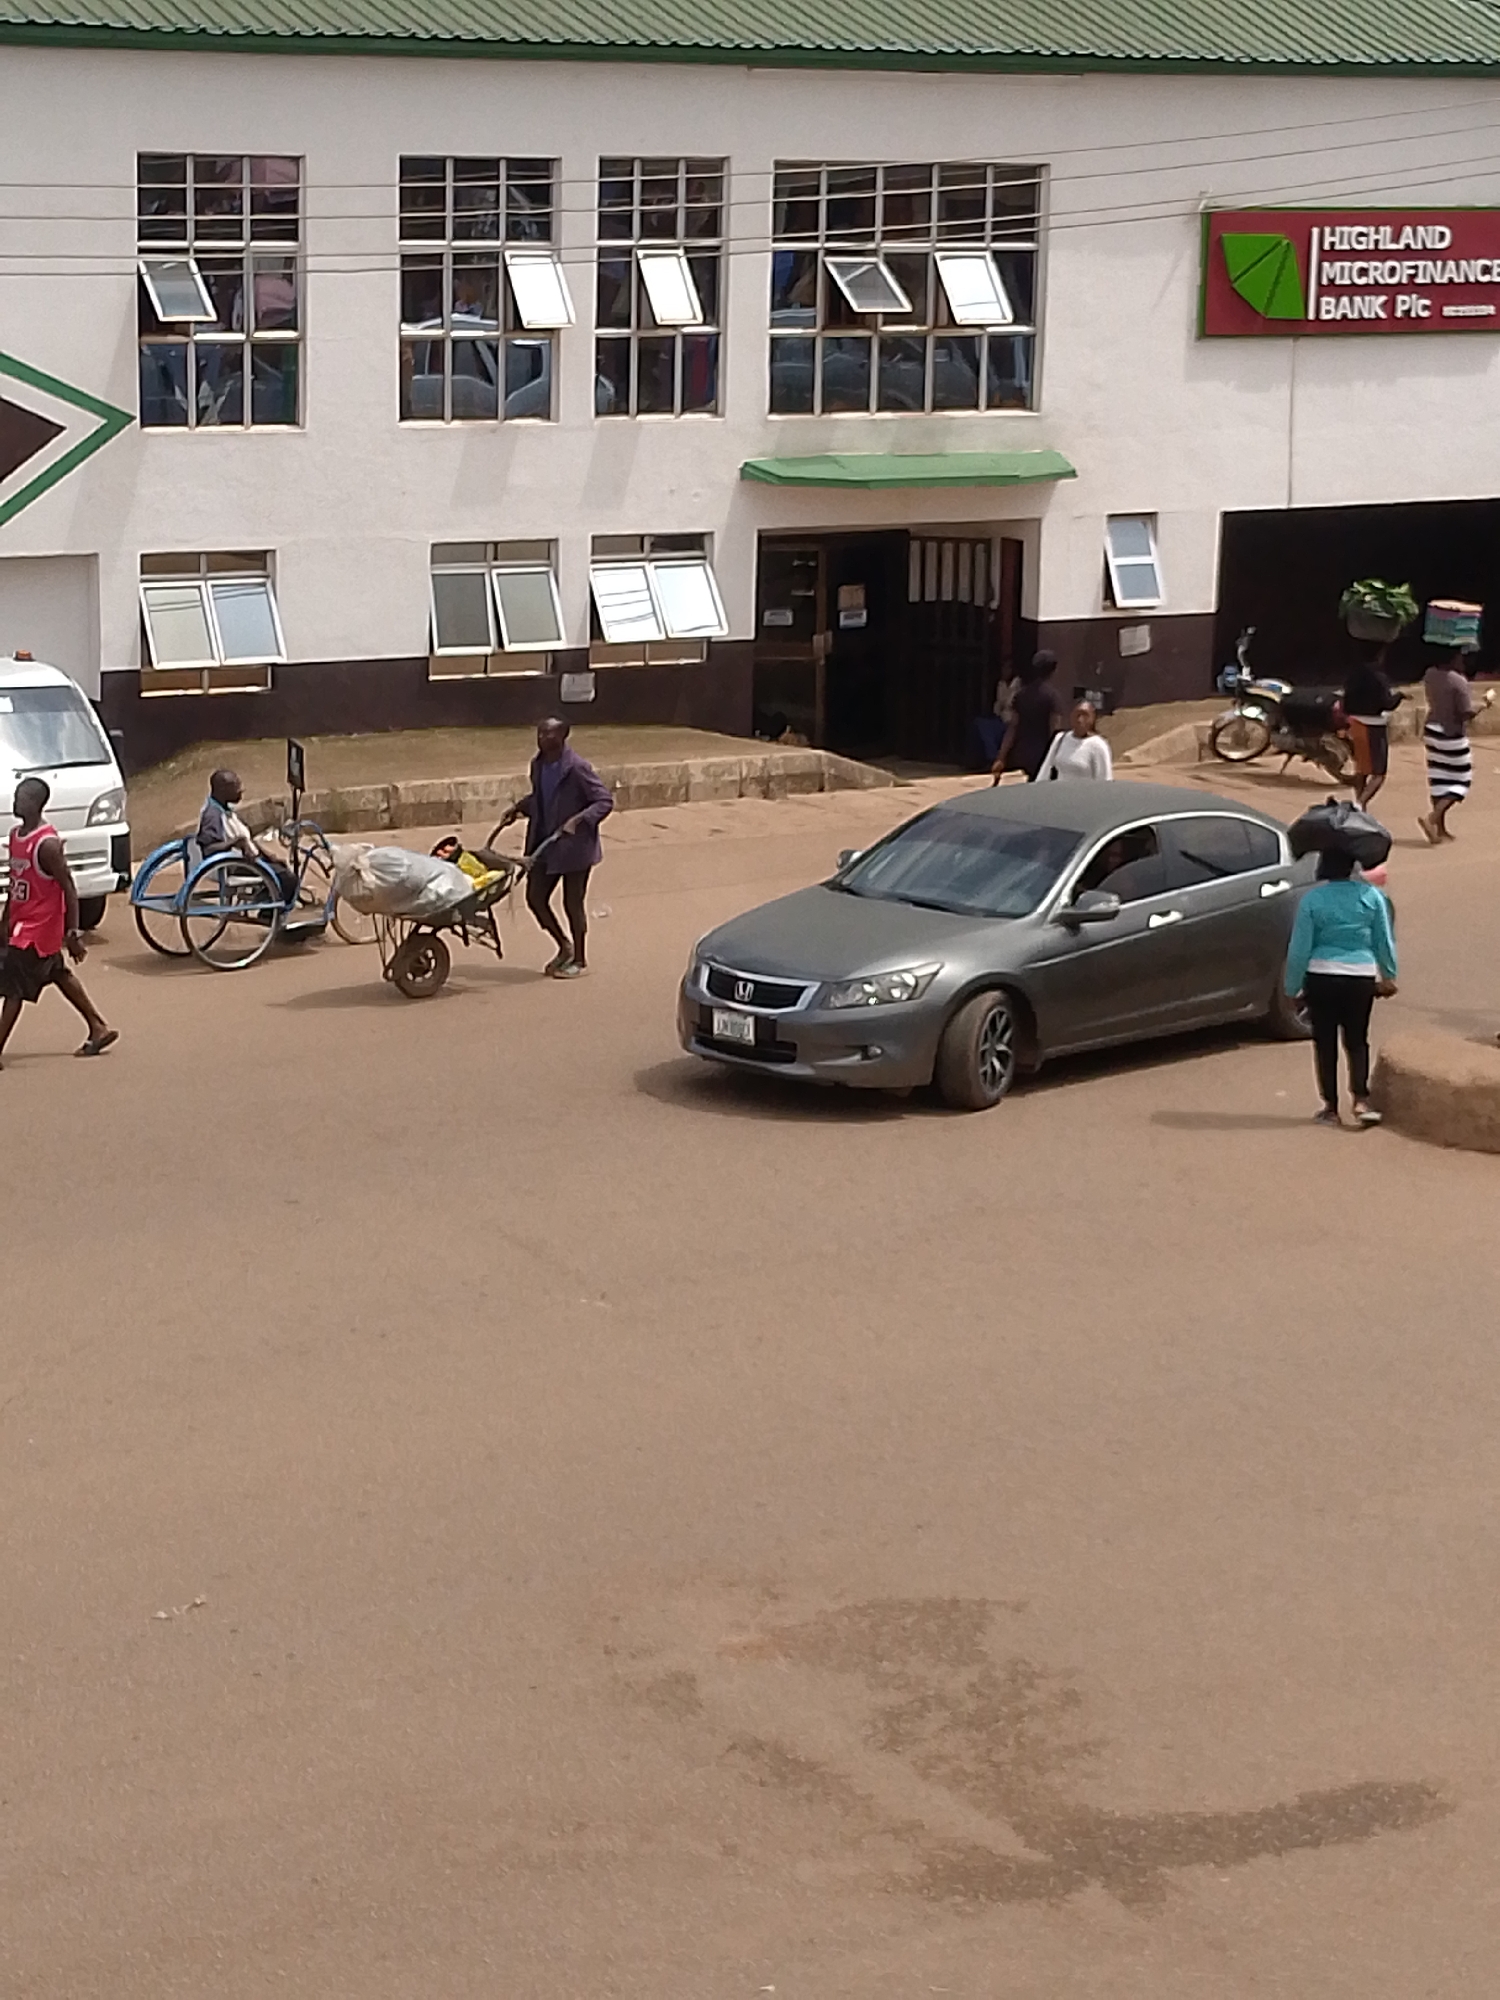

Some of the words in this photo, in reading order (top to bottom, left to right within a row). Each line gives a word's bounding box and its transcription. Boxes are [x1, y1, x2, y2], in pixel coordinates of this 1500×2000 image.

[1322, 225, 1452, 250] HIGHLAND
[1320, 259, 1500, 285] MICROFINANCE
[1319, 296, 1388, 320] BANK
[1394, 294, 1432, 318] Plc
